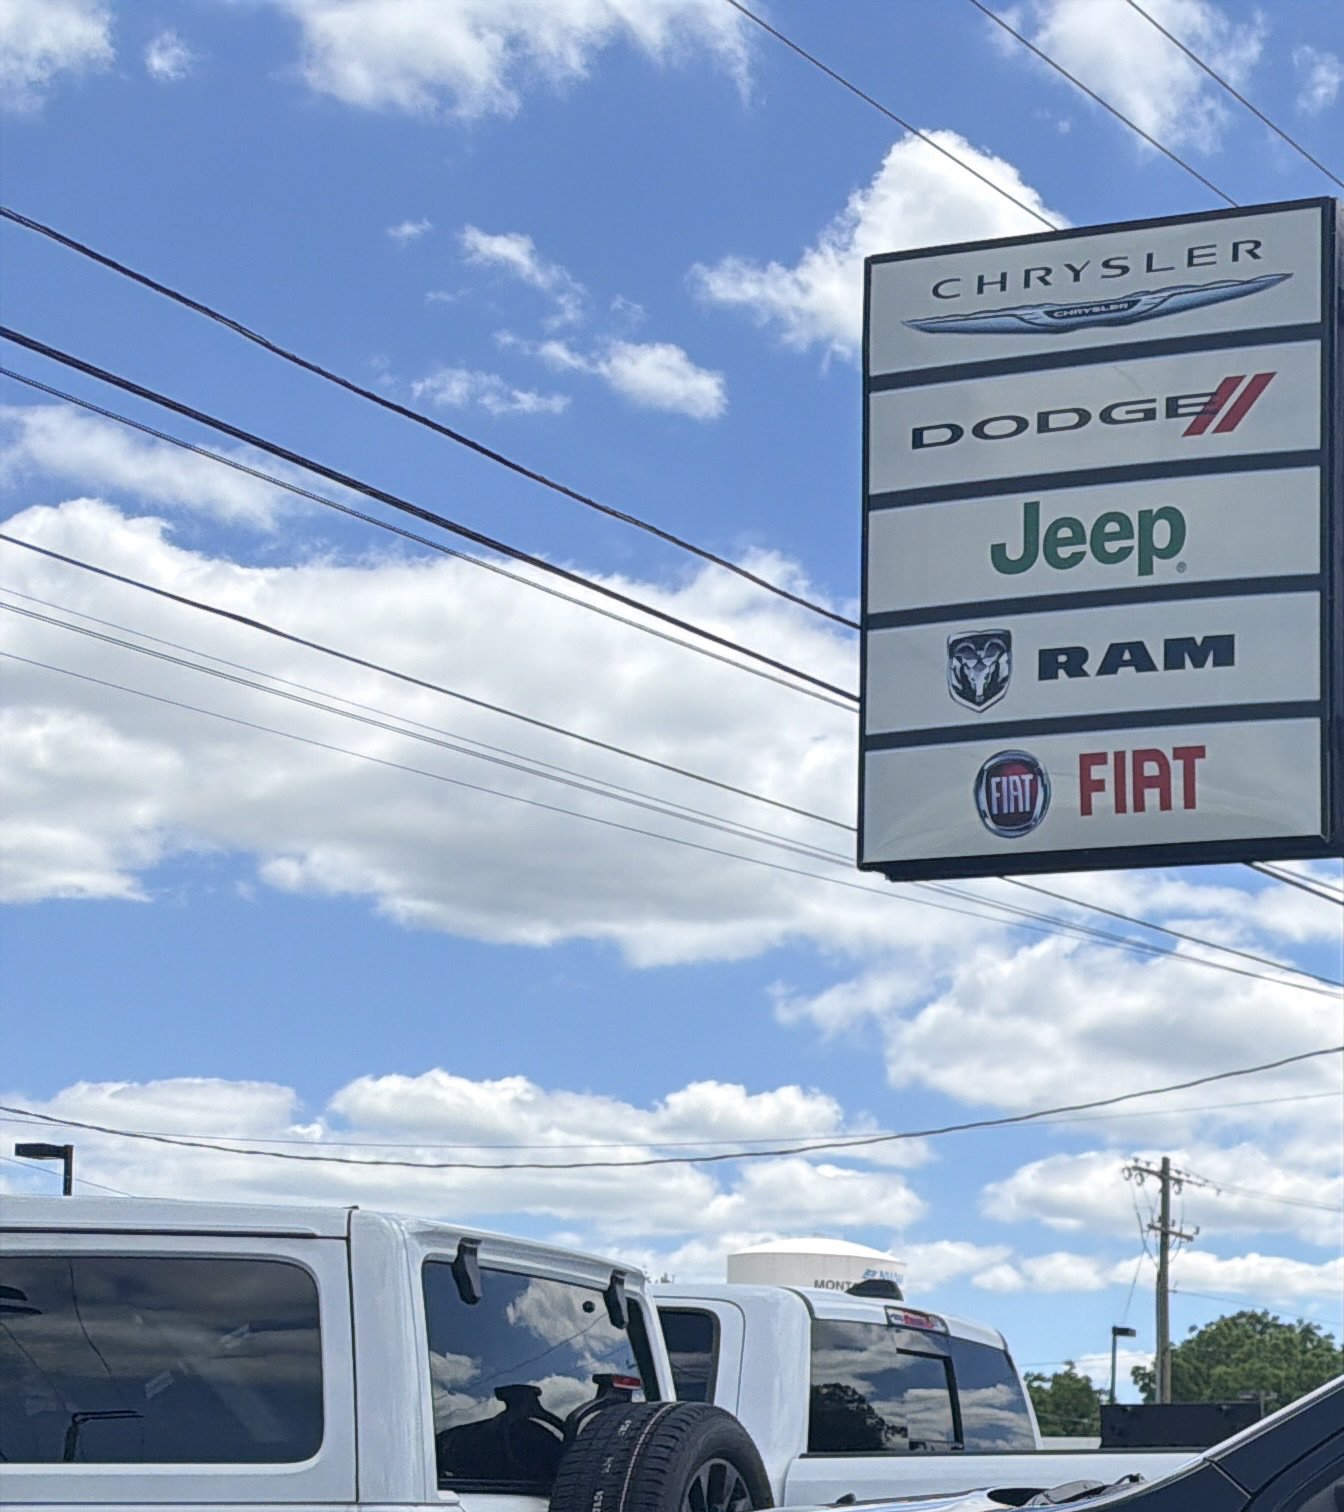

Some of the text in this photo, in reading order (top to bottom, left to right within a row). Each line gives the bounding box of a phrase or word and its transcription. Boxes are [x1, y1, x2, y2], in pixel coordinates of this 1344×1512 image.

[931, 238, 1263, 300] CHRYSLER
[1052, 302, 1129, 318] CHRYSLER
[911, 390, 1222, 450] DODGE
[990, 500, 1187, 577] Jeep
[1037, 633, 1236, 682] RAM
[990, 773, 1034, 815] FIAT
[1078, 745, 1206, 817] FIAT
[814, 1280, 857, 1291] MONT
